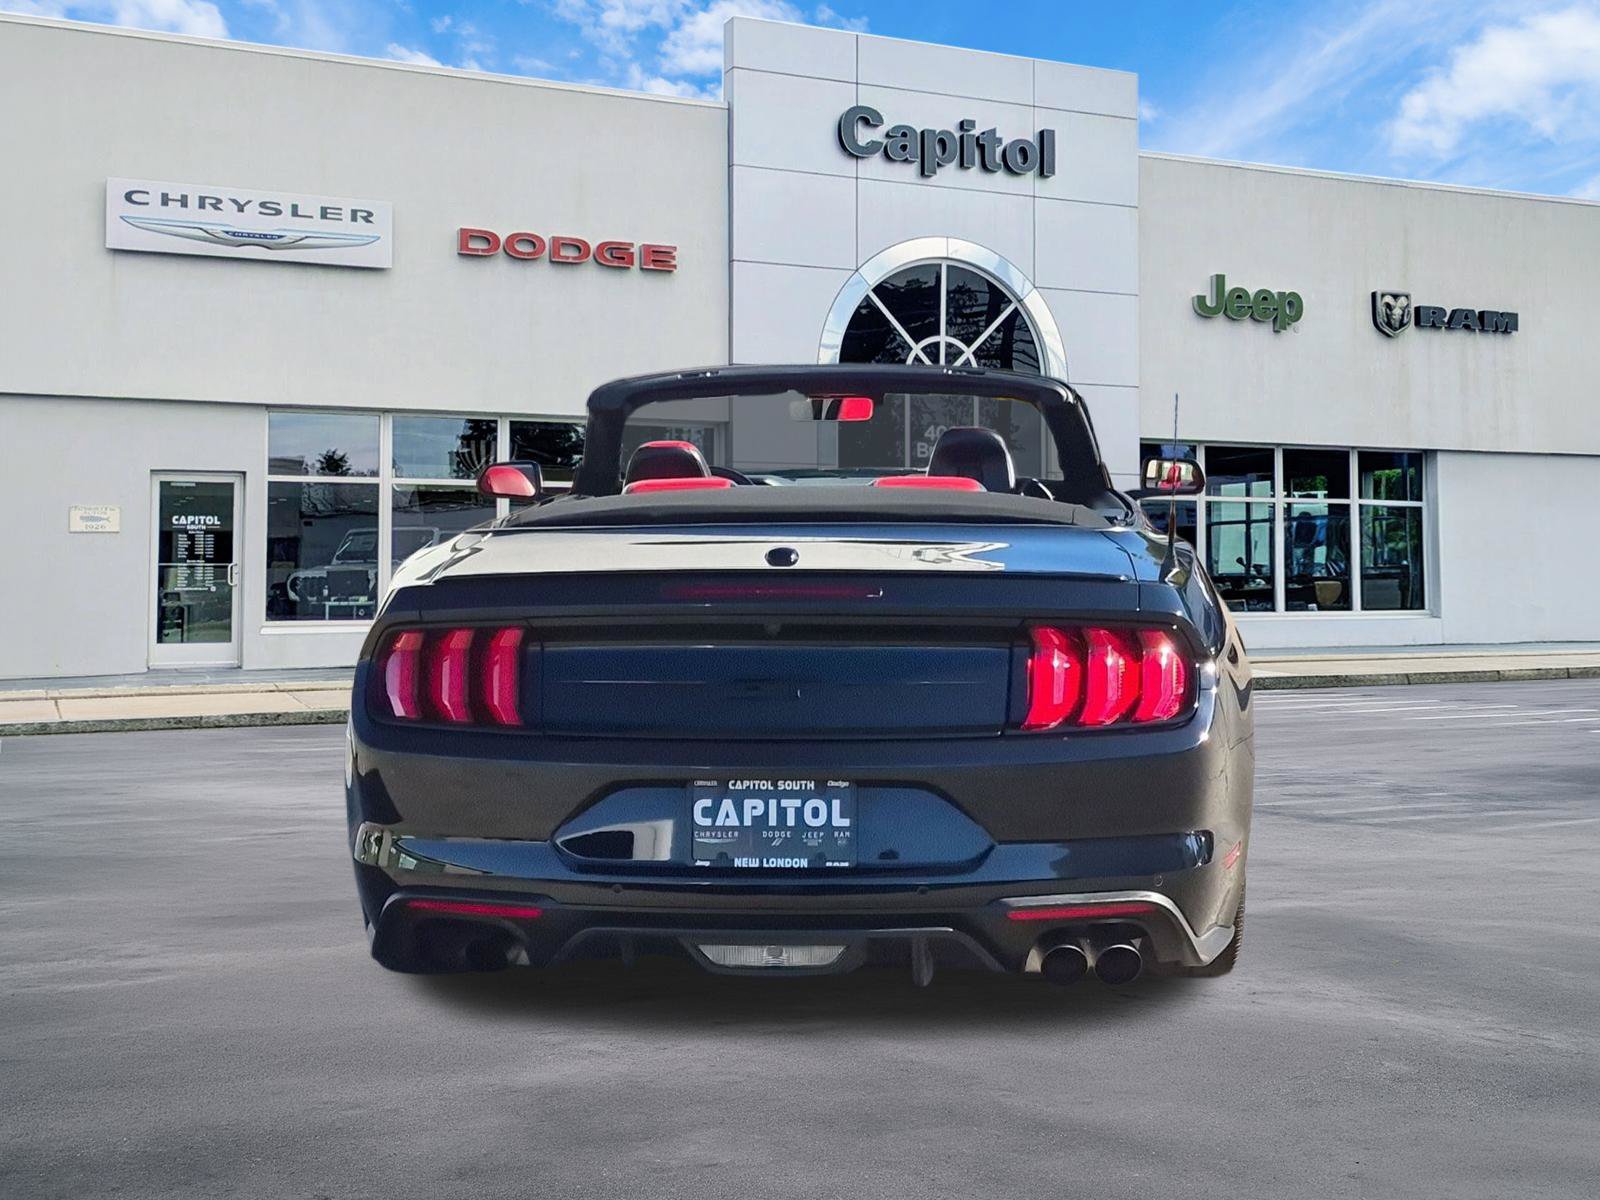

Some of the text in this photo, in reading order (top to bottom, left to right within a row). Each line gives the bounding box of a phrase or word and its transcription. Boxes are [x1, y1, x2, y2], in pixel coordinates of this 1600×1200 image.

[838, 105, 1056, 178] Capitol
[123, 189, 375, 225] CHRYSLER
[457, 227, 678, 273] DODGE
[1191, 274, 1304, 333] Jeep
[1414, 304, 1519, 333] RAM
[172, 515, 221, 525] CAPITOL
[728, 780, 815, 790] CAPITOL SOUTH
[693, 798, 851, 827] CAPITOL
[694, 830, 739, 838] CHRYSLER
[762, 830, 792, 838] DODGE
[801, 831, 825, 839] JEEP
[734, 857, 808, 868] NEW LONDON
